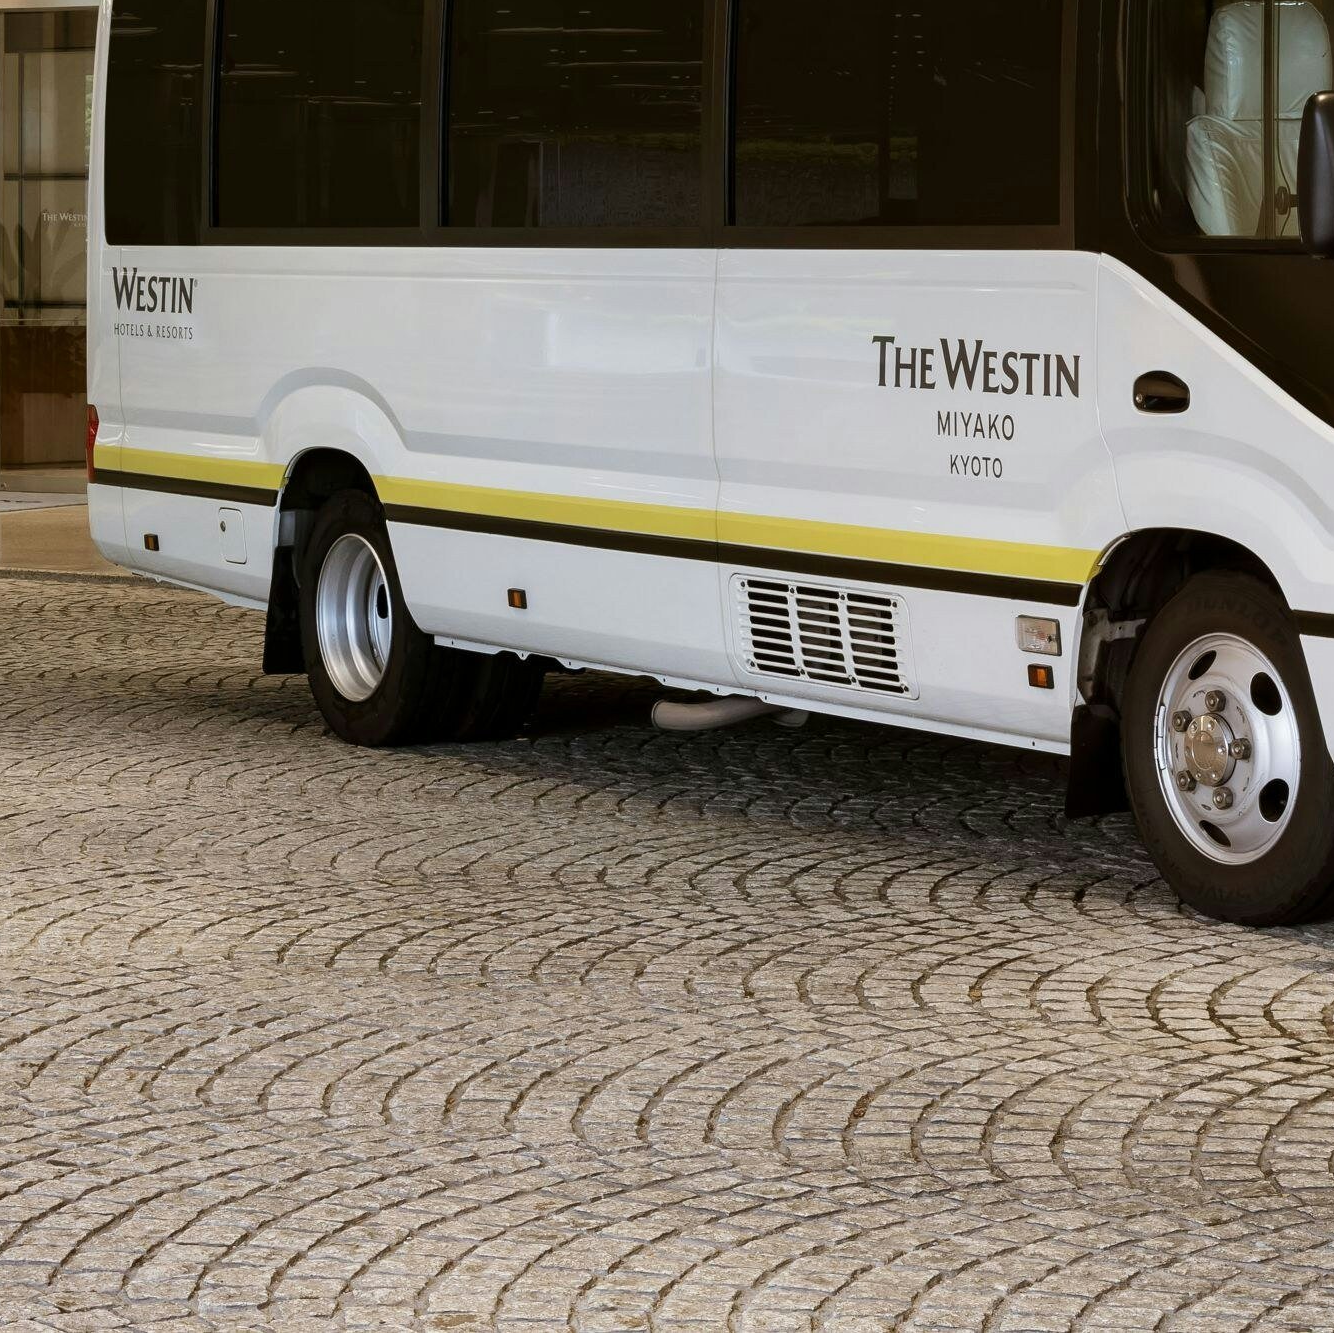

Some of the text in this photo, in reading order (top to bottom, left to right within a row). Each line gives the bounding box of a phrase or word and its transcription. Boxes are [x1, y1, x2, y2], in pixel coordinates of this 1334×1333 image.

[42, 212, 58, 221] THE
[114, 323, 193, 340] HOTELS & RESORTS
[872, 335, 1081, 398] THE WESTIN
[937, 410, 1015, 441] MIYAKO
[950, 454, 1003, 478] KYOTO
